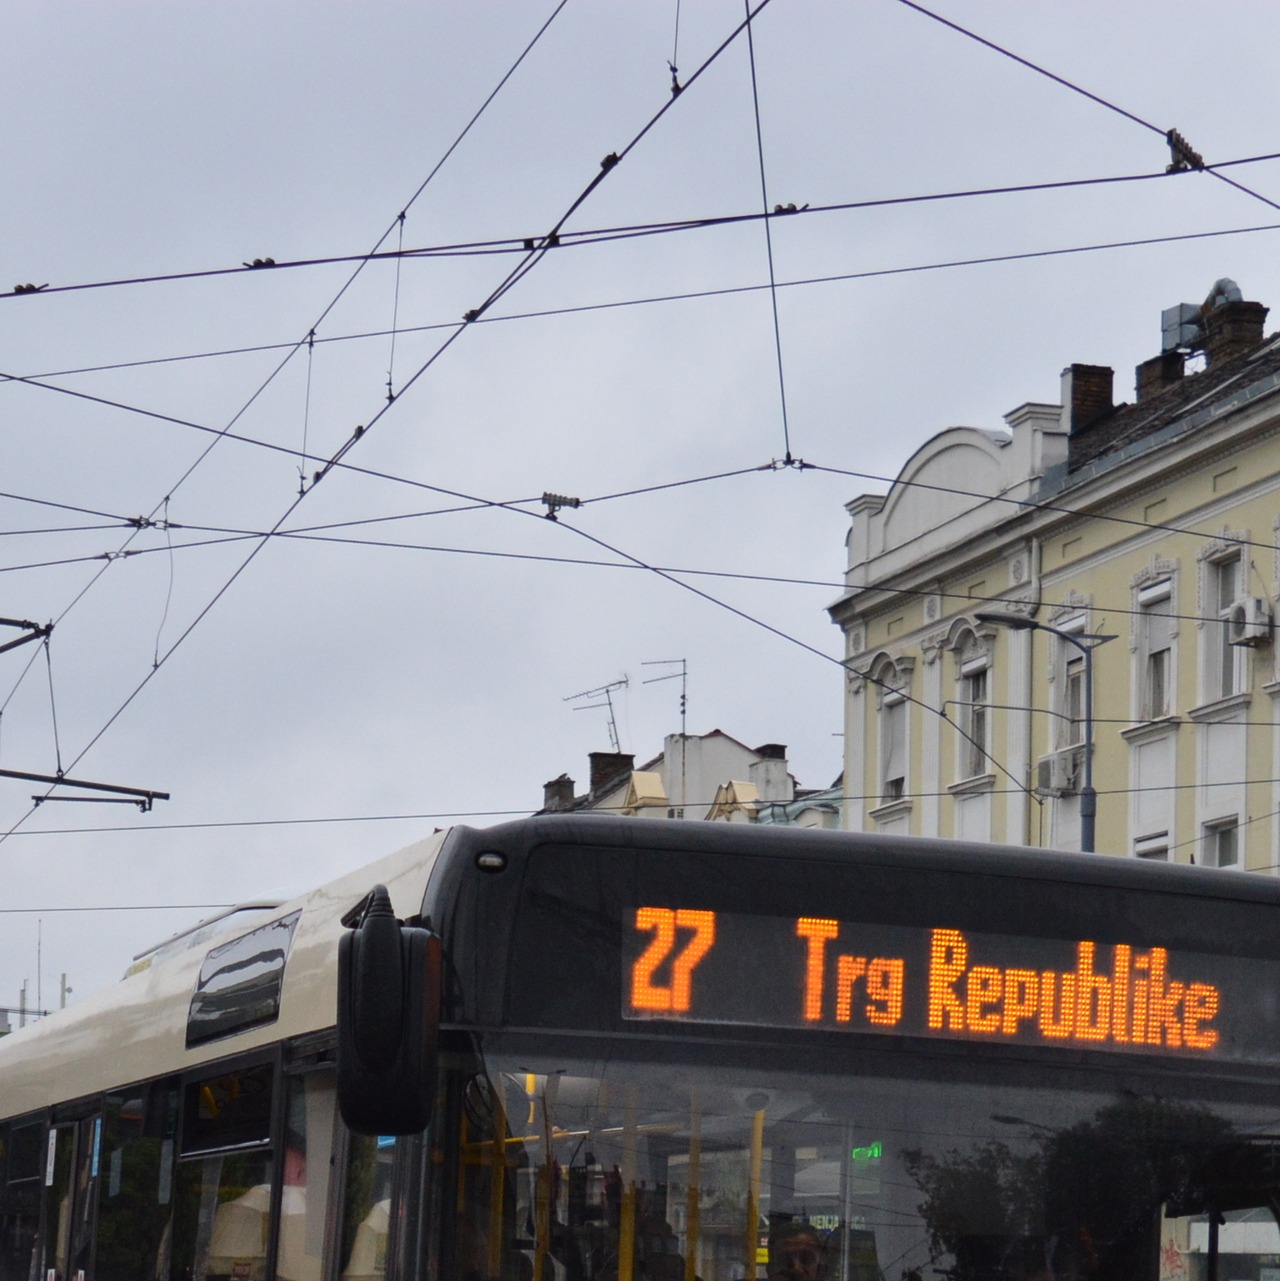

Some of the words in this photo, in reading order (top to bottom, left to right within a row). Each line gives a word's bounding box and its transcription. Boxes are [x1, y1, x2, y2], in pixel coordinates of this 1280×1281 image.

[631, 906, 716, 1012] 27
[796, 917, 905, 1026] Trg
[928, 928, 1219, 1049] Republike
